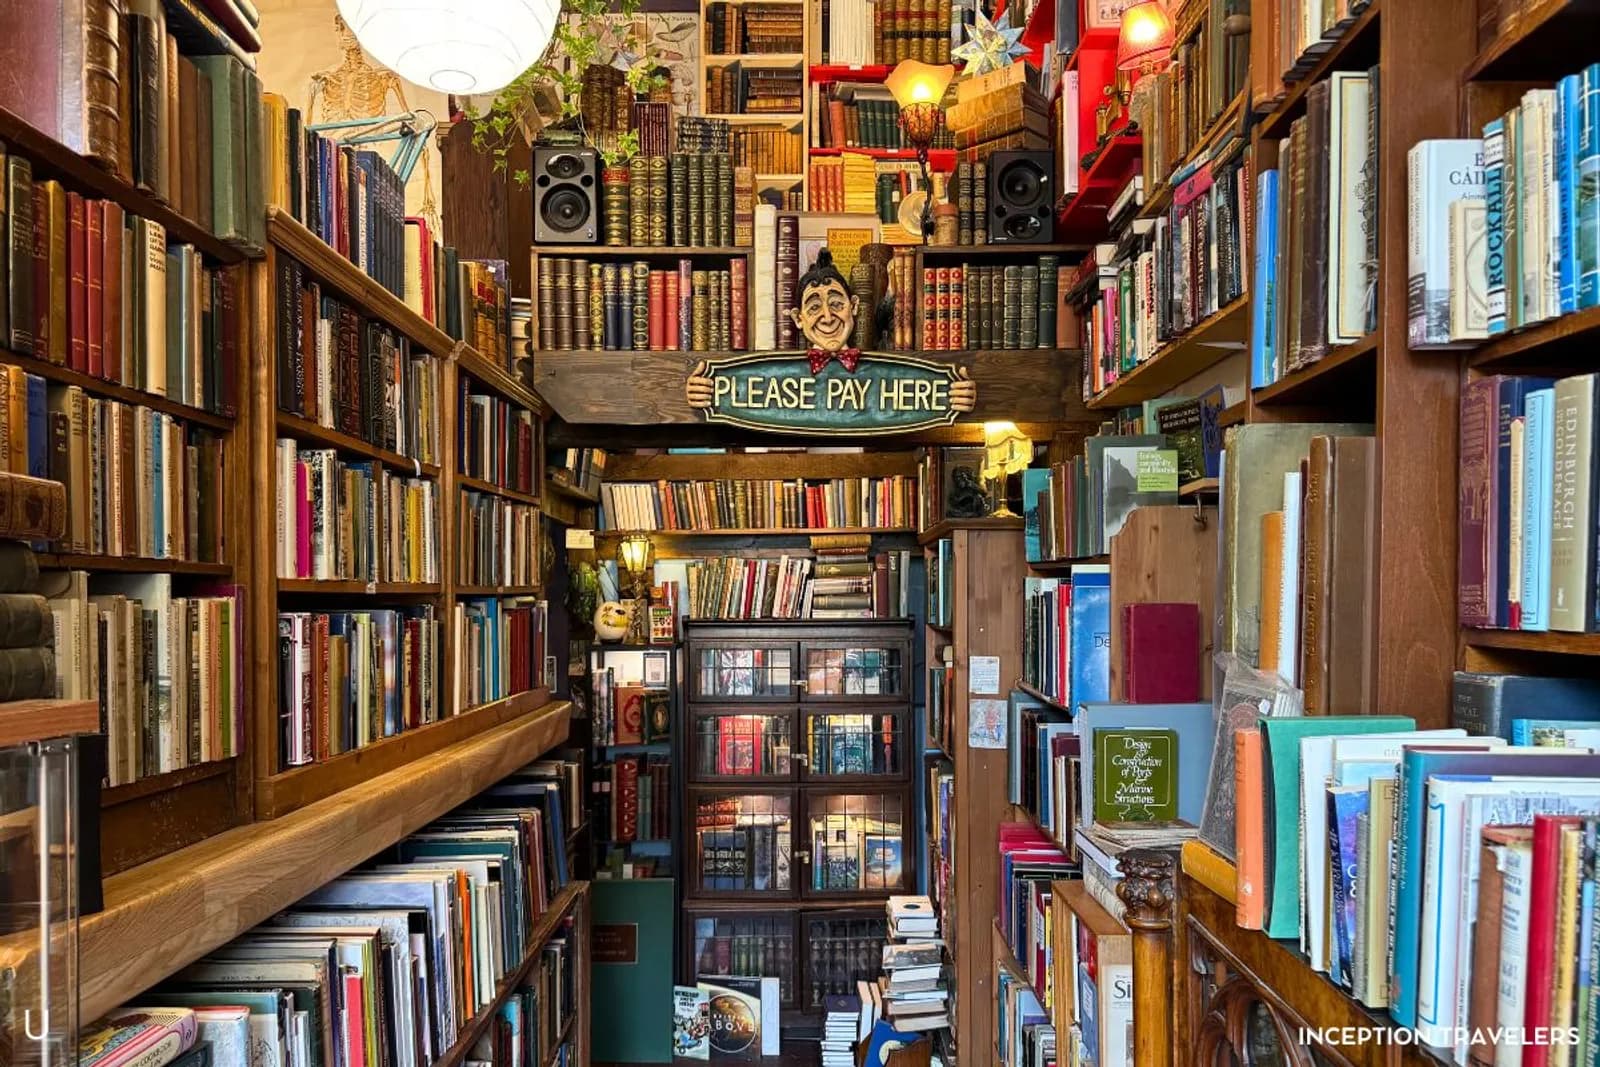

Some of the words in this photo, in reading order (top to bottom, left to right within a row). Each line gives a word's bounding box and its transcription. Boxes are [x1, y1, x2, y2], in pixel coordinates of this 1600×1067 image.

[1487, 167, 1503, 288] ROCKALL
[714, 376, 816, 410] PLEASE
[826, 378, 872, 410] PAY
[879, 379, 949, 411] HERE
[1554, 426, 1564, 494] GOLDEN
[1563, 407, 1578, 529] EDINBURGH
[1553, 498, 1562, 530] AGE
[1123, 738, 1152, 753] Design
[1112, 755, 1163, 767] Construction
[1121, 766, 1132, 779] of
[1132, 766, 1153, 777] Ports
[1114, 791, 1155, 804] Structures
[1118, 782, 1153, 794] Marine
